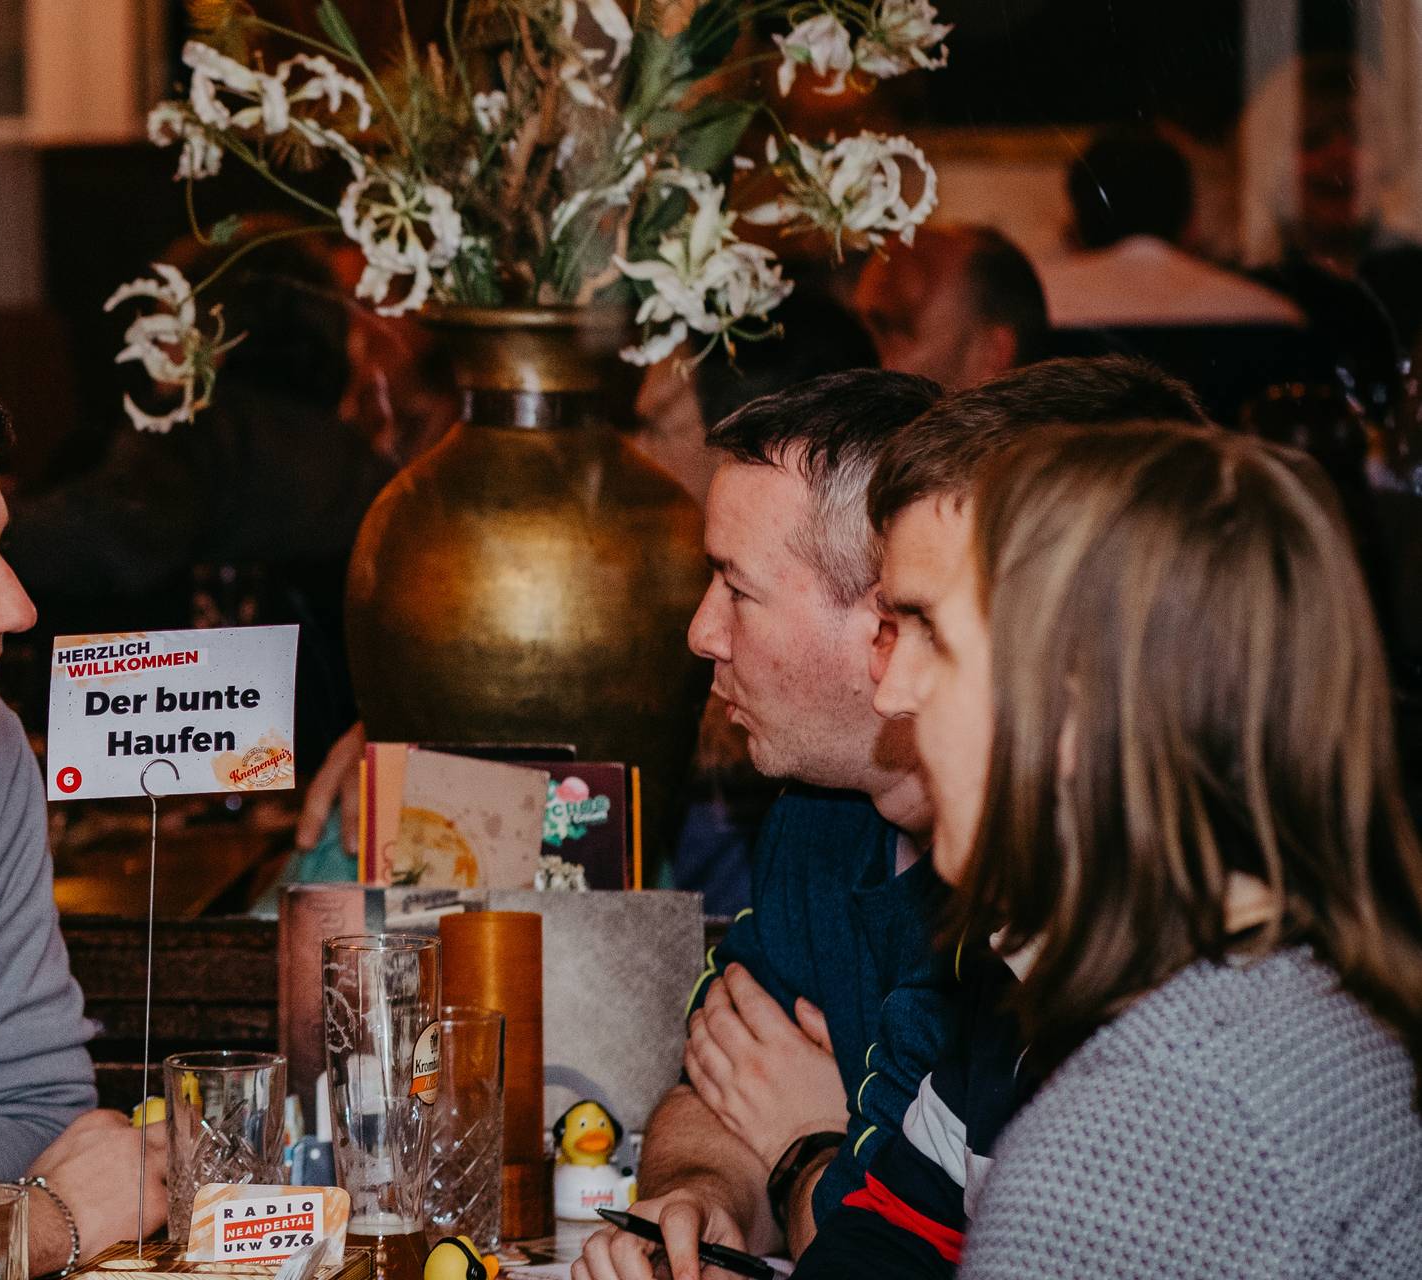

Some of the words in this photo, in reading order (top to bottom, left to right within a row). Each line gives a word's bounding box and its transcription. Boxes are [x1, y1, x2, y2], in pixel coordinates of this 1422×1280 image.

[57, 641, 150, 664] HERZLICH
[67, 650, 199, 678] WILLKOMMEN
[85, 691, 147, 716] Der
[155, 685, 261, 712] bunte
[108, 726, 235, 756] Haufen
[229, 748, 292, 783] Kneipenquiz
[62, 773, 75, 786] 6
[414, 1057, 439, 1074] Kromb
[223, 1201, 314, 1219] RADIO
[226, 1217, 312, 1239] NEANDERTAL
[224, 1241, 263, 1253] UKW
[269, 1233, 314, 1249] 97.6
